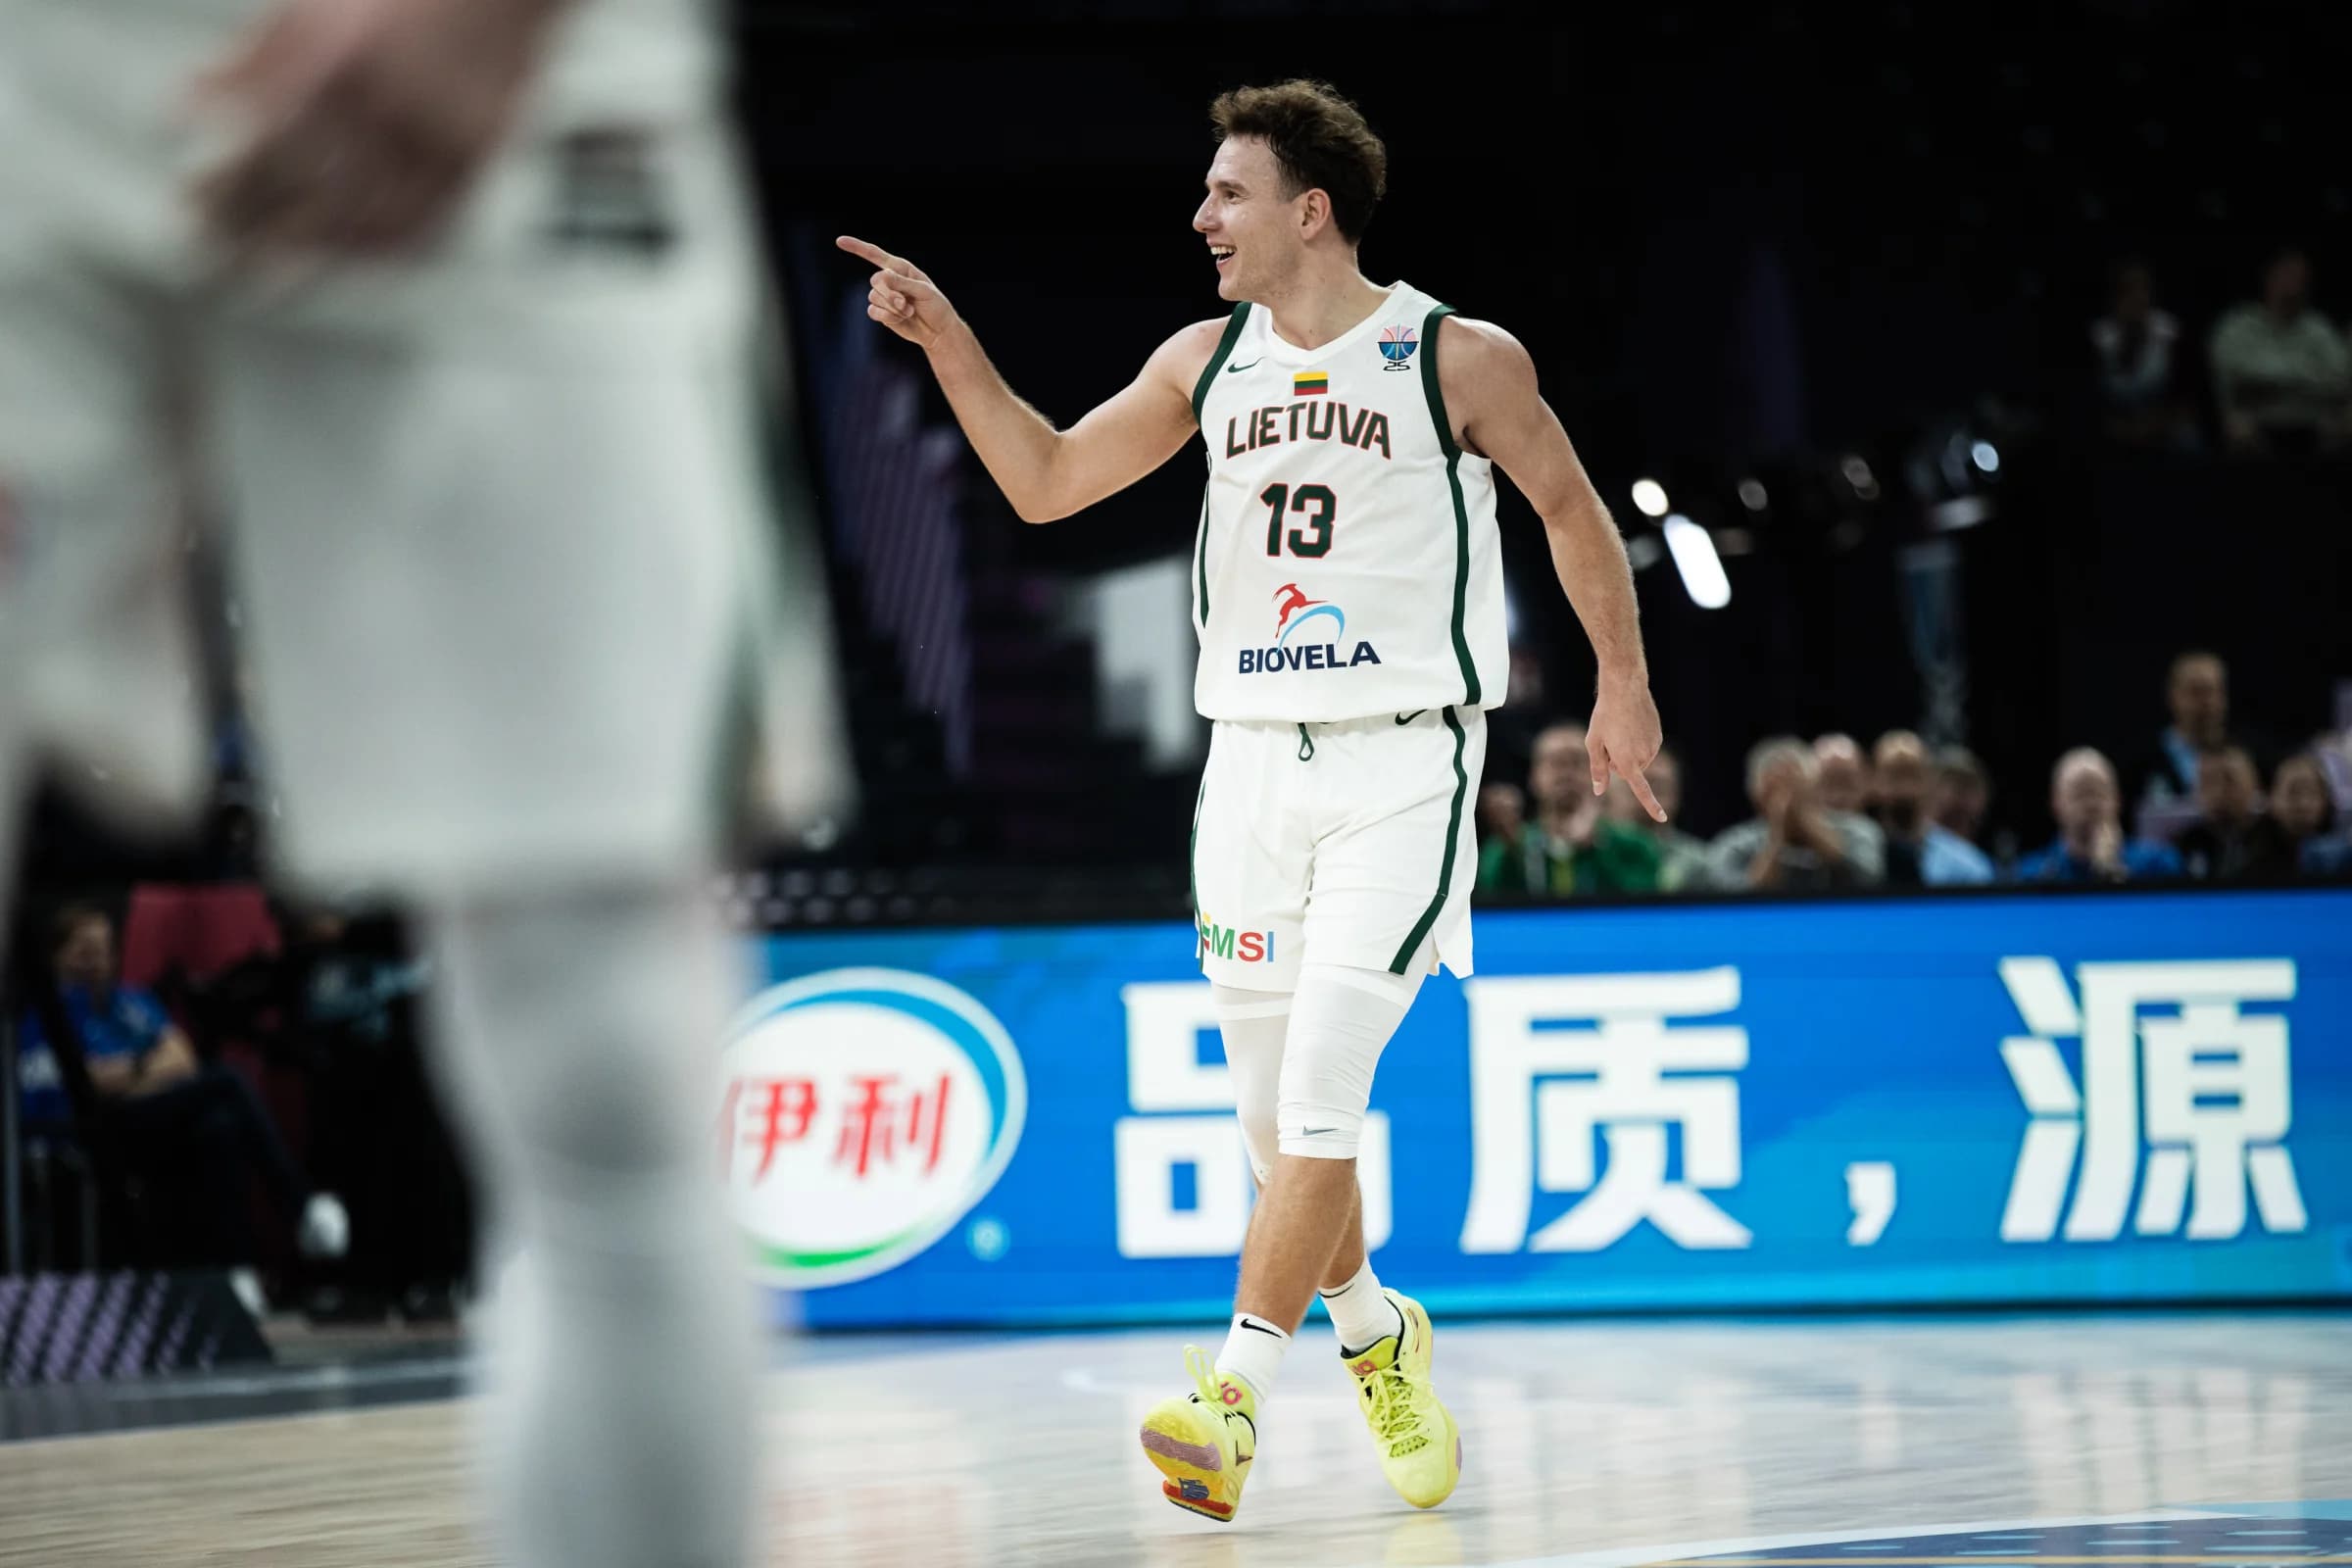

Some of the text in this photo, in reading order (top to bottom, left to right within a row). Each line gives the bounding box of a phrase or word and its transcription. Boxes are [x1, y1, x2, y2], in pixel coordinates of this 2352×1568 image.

[1226, 401, 1392, 461] LIETUVA
[1260, 482, 1338, 559] 13
[1239, 640, 1382, 674] BIOVELA
